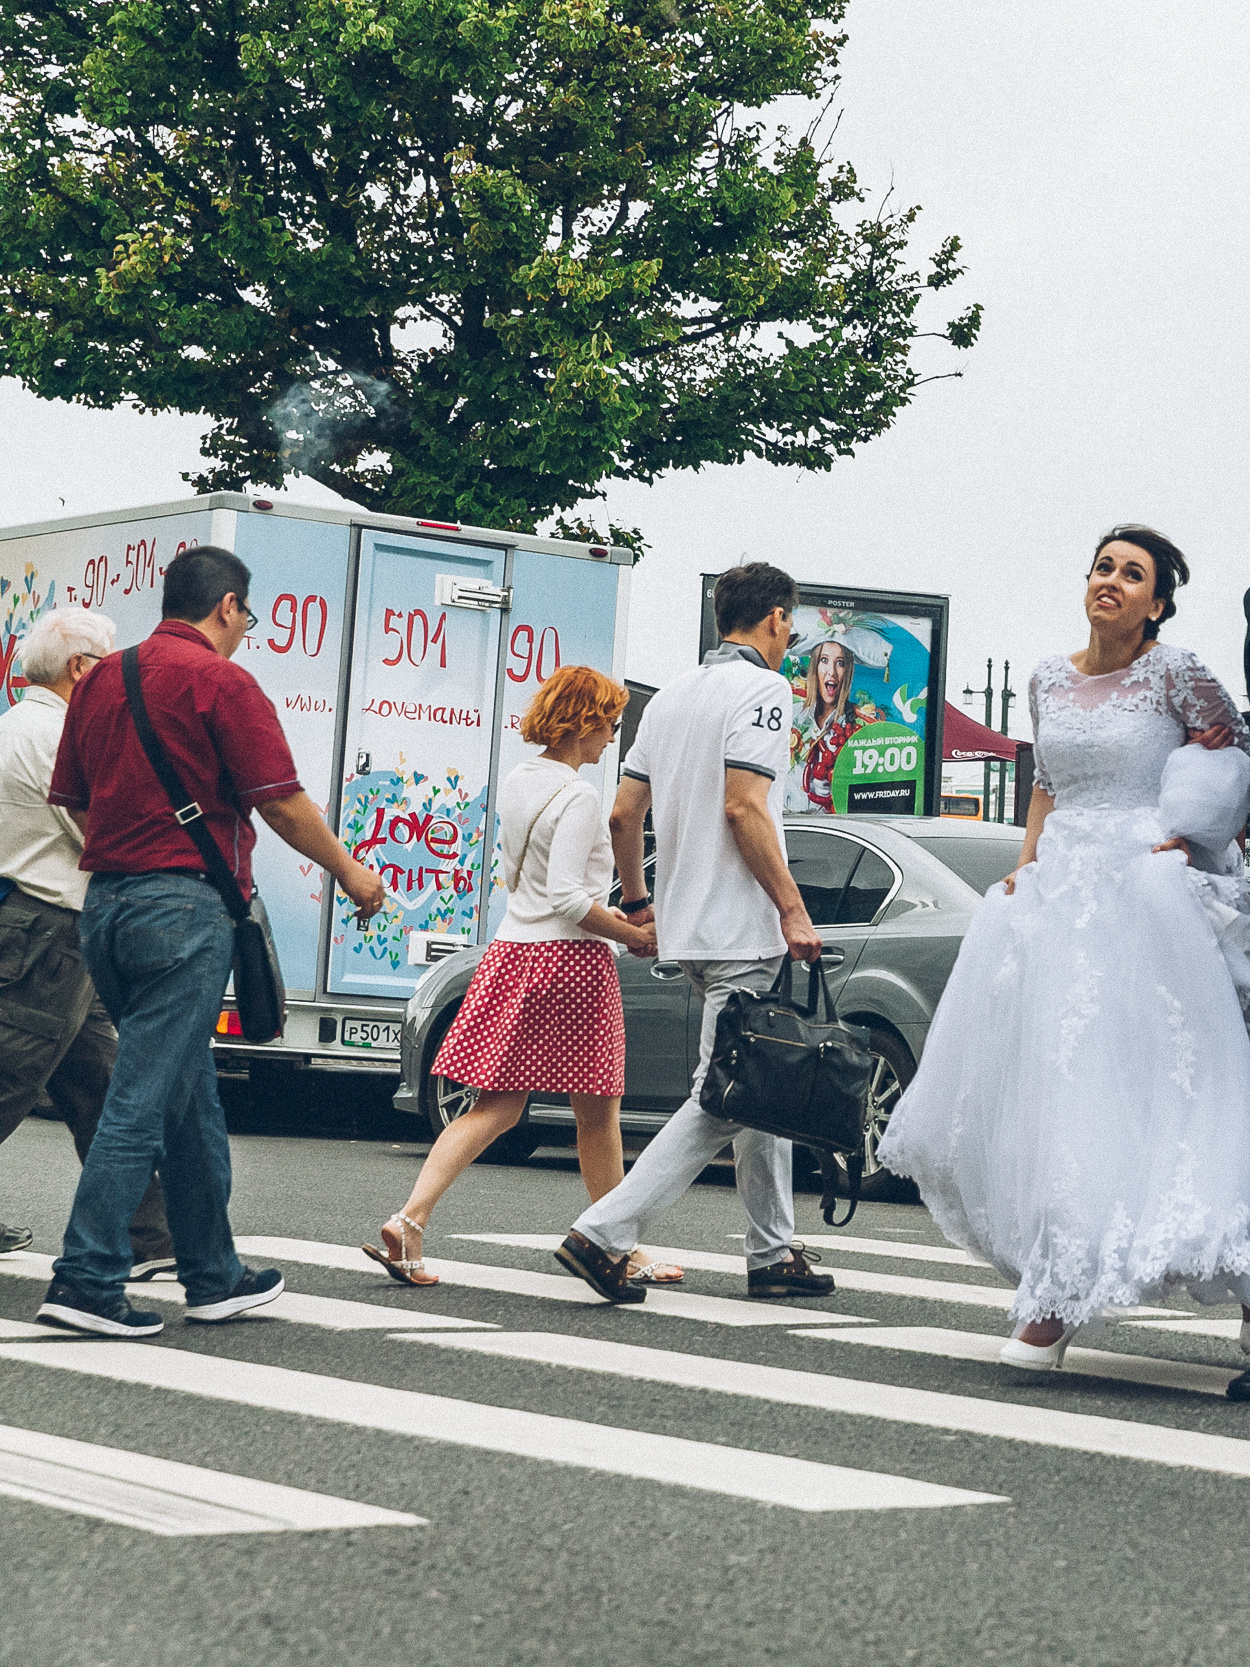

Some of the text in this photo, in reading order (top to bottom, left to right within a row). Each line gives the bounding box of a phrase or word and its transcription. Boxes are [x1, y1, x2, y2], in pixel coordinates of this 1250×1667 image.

[828, 600, 855, 608] POSTER
[267, 593, 328, 658] 90
[382, 608, 447, 668] 501
[506, 624, 560, 685] 90
[751, 706, 783, 731] 18
[885, 735, 919, 745] ВТОРНИК
[852, 745, 918, 775] 19:00
[853, 789, 911, 800] WWW.FRIDAY.RU
[368, 863, 475, 894] анты
